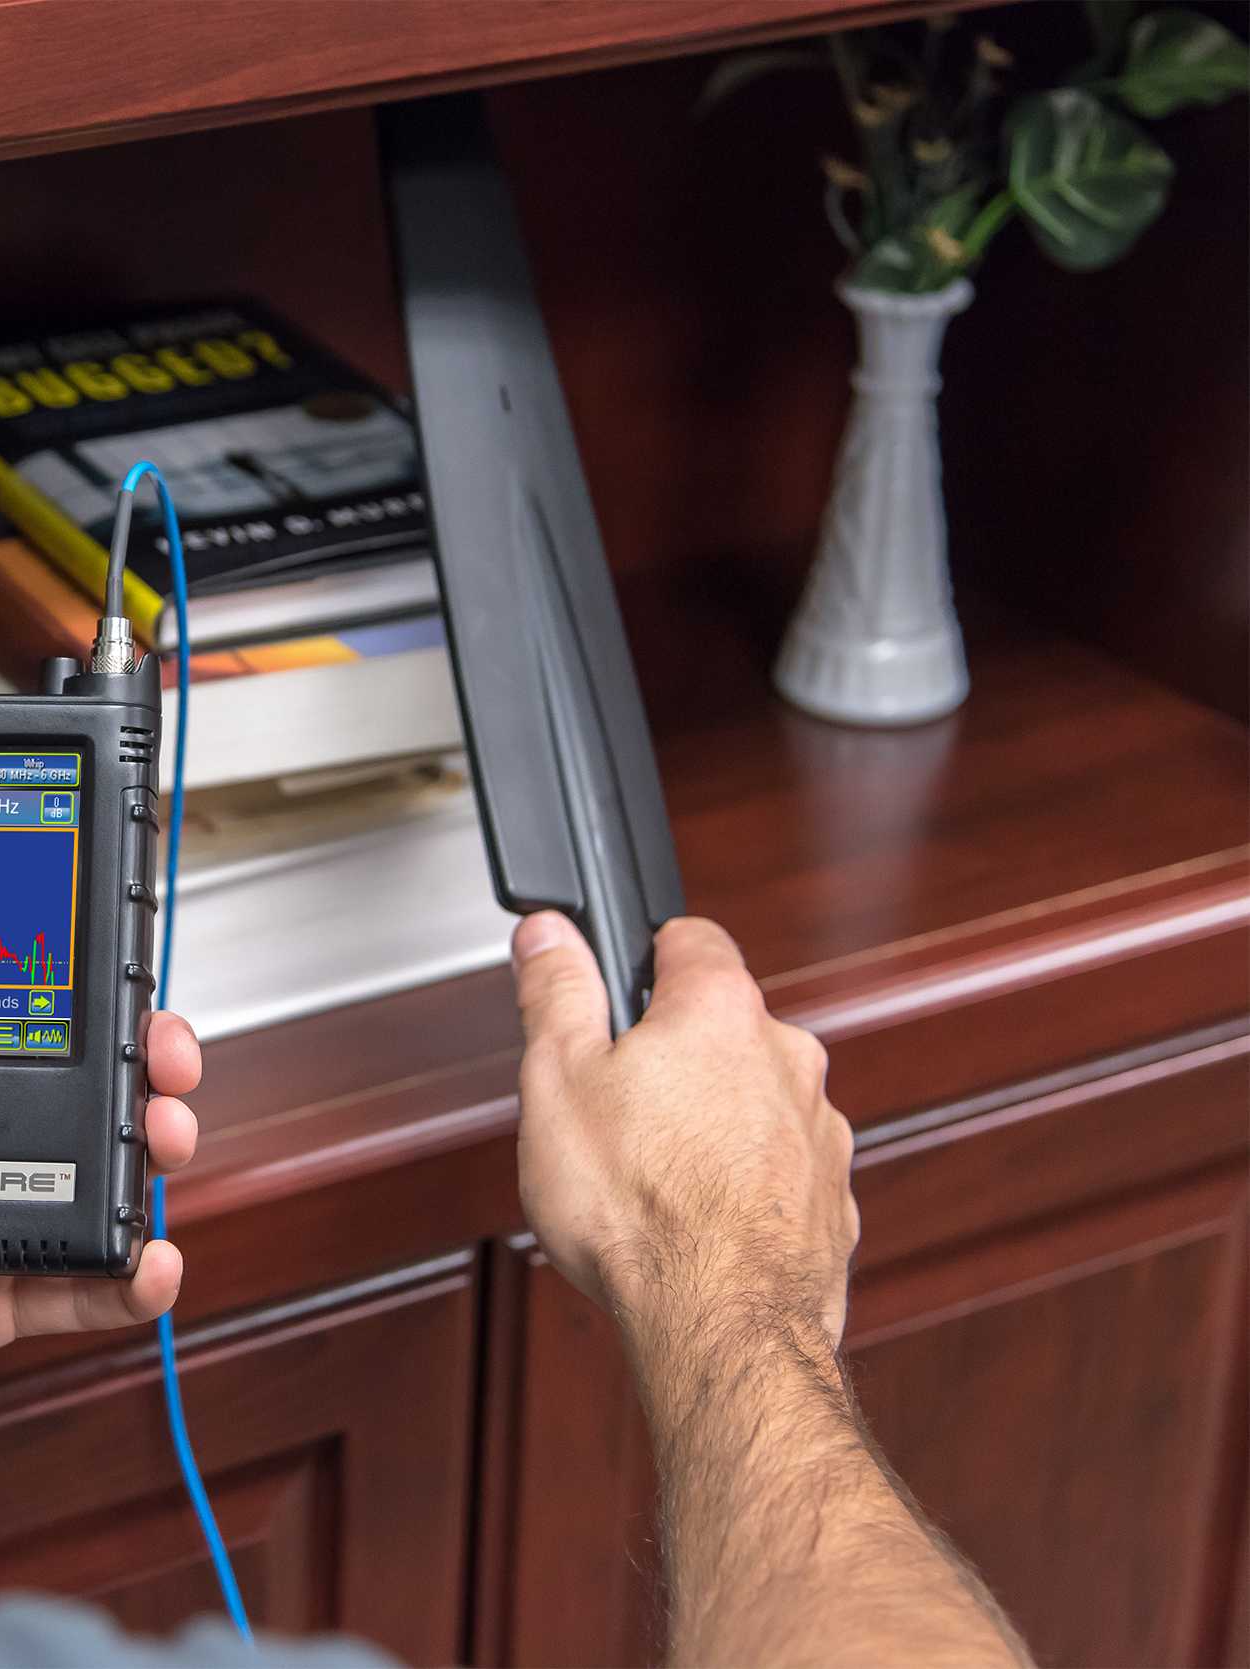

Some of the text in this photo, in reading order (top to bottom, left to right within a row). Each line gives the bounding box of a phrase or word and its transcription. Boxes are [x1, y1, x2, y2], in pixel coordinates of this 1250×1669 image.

[155, 519, 277, 556] EVIN
[10, 769, 33, 781] MHz
[49, 769, 71, 781] GHz
[50, 808, 63, 818] dB
